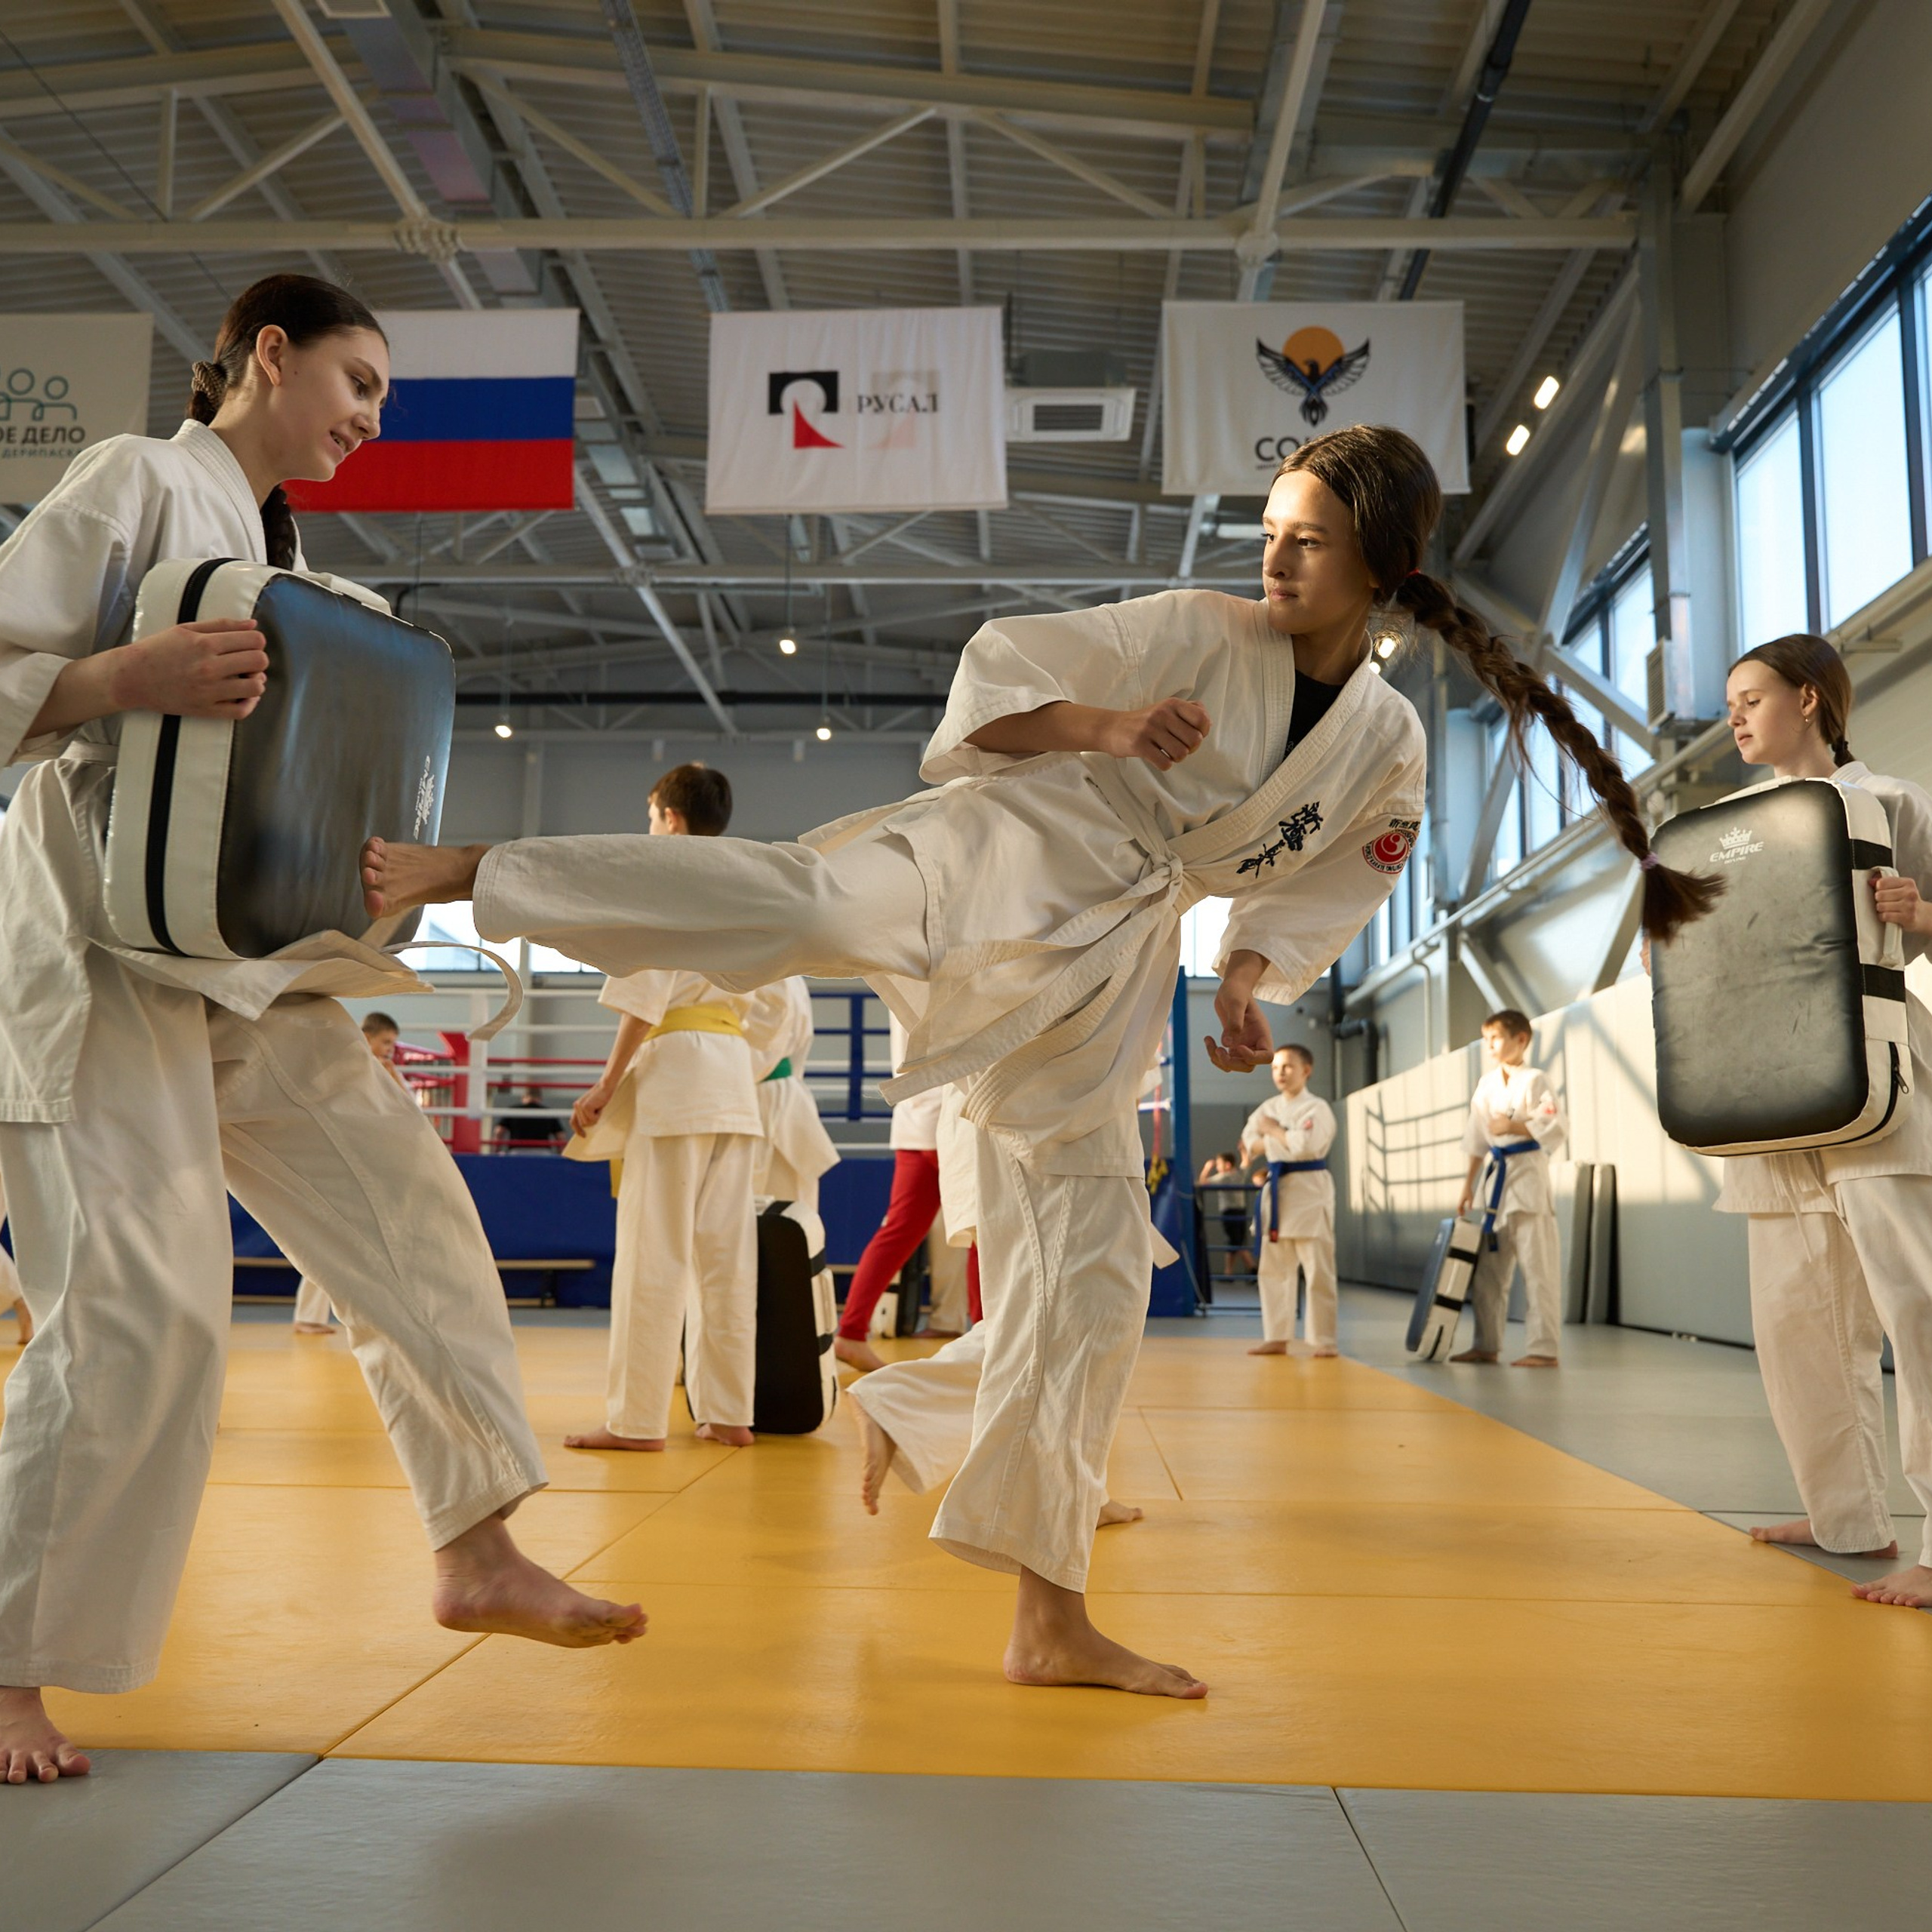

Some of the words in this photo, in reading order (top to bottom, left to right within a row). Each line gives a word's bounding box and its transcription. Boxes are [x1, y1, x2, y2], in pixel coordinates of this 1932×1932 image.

[857, 392, 939, 413] РУСАЛ
[21, 426, 86, 445] ДЕЛО
[1709, 841, 1764, 863] EMPIRE
